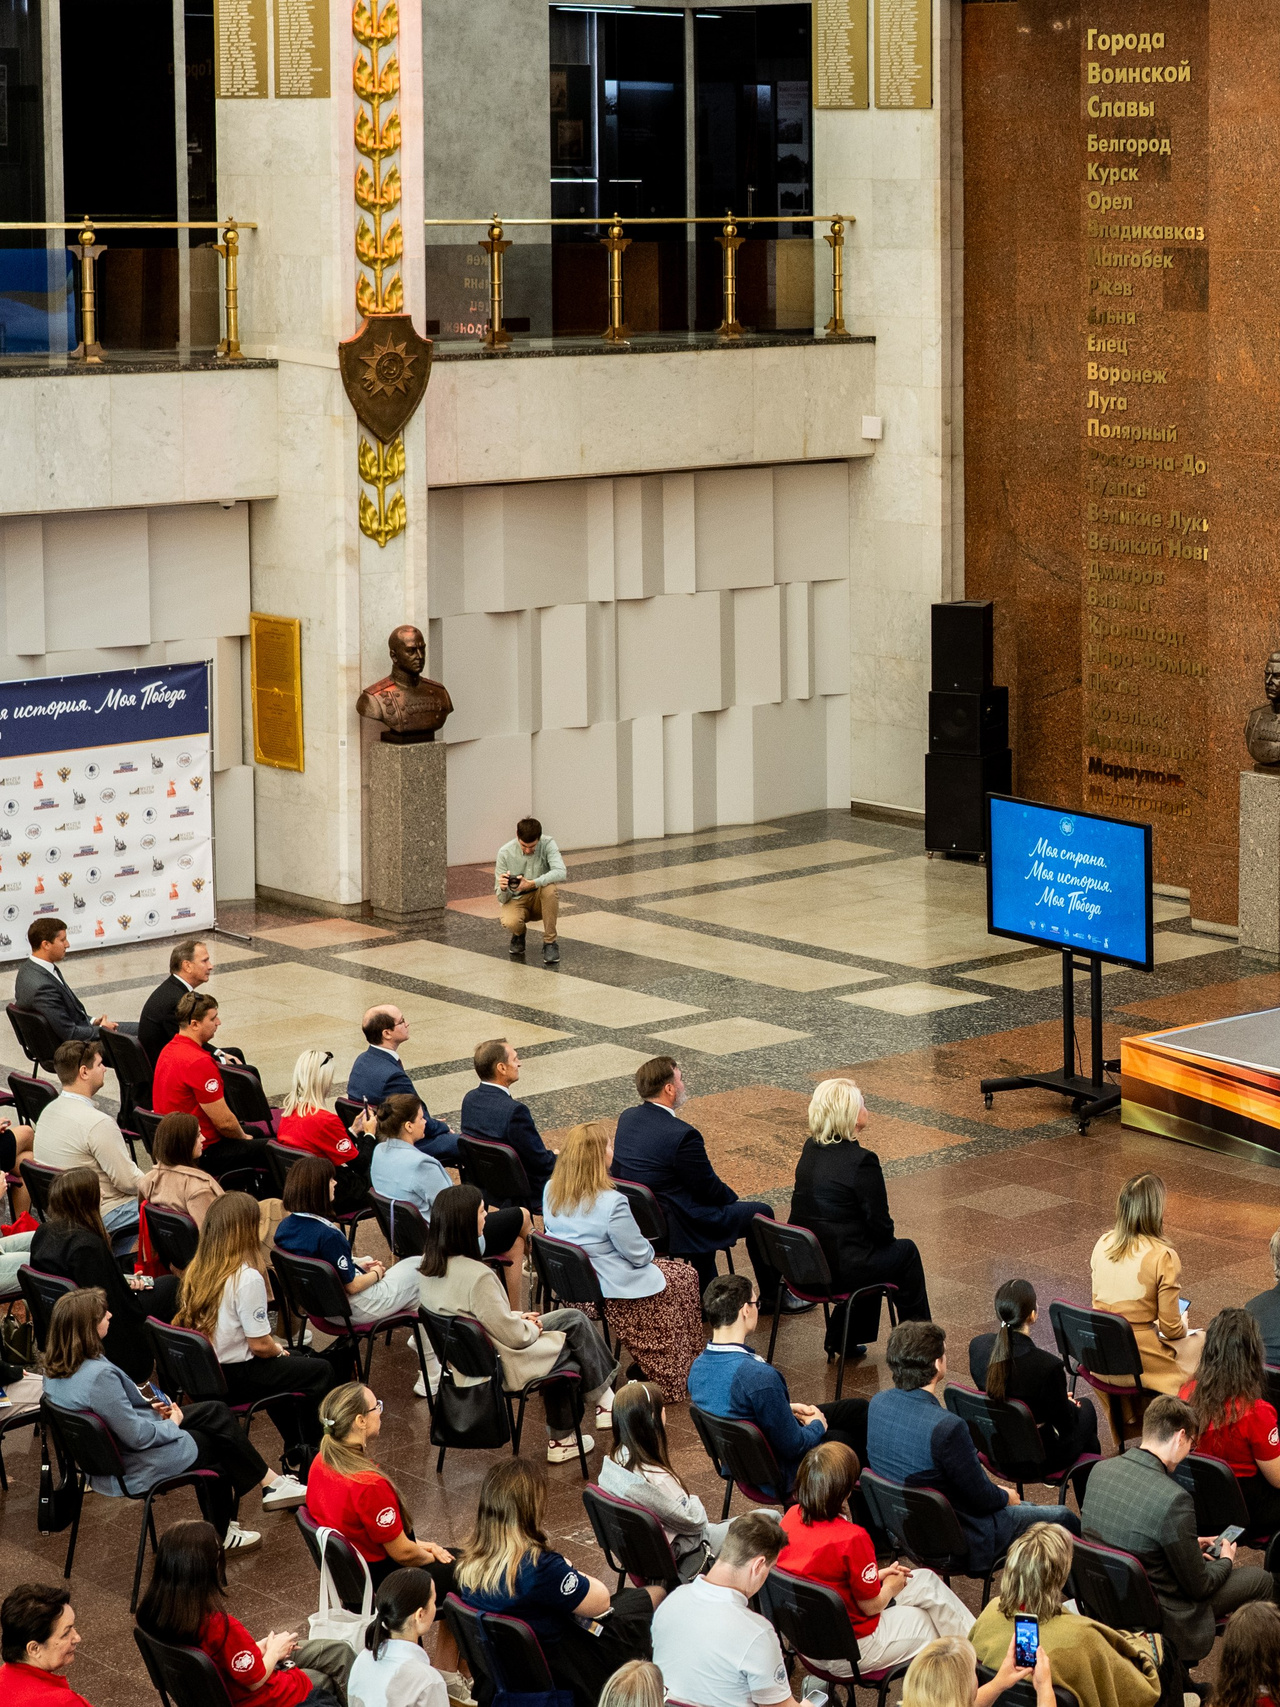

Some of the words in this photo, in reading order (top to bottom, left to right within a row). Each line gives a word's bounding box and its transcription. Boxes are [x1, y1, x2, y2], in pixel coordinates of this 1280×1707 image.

[1087, 29, 1165, 56] Города
[1087, 60, 1191, 85] Воинской
[1087, 95, 1155, 119] Славы
[1087, 134, 1171, 156] Белгород
[1087, 163, 1139, 186] Курск
[1087, 191, 1133, 212] Орел
[1088, 219, 1205, 241] Владикавказ
[1088, 247, 1174, 268] Малгобек
[1088, 278, 1133, 296] Ржев
[1088, 306, 1136, 325] Ельня
[1087, 334, 1128, 356] Елец
[1087, 363, 1167, 385] Воронеж
[1087, 391, 1128, 414] Луга
[1087, 419, 1178, 443] Полярный
[1088, 450, 1209, 476] Ростов-на-До
[1088, 475, 1147, 498] Туапсе
[1087, 502, 1162, 528] Великие
[1088, 532, 1163, 557] Великий
[1088, 560, 1164, 586] Дмитров
[1087, 588, 1150, 612] Вязьма
[1088, 616, 1186, 647] Кронштадт
[1088, 673, 1139, 696] Псков
[14, 699, 91, 720] история.
[95, 688, 136, 714] Моя
[141, 681, 187, 710] Победа
[1088, 729, 1198, 761] Архангельск
[1089, 757, 1185, 787] Мариуполь
[1089, 786, 1192, 817] Мелитополь
[1028, 837, 1058, 858] Моя
[1060, 849, 1107, 869] страна.
[1025, 860, 1054, 881] Моя
[1057, 871, 1112, 894] история.
[1035, 886, 1065, 908] Моя
[1067, 891, 1102, 920] Победа
